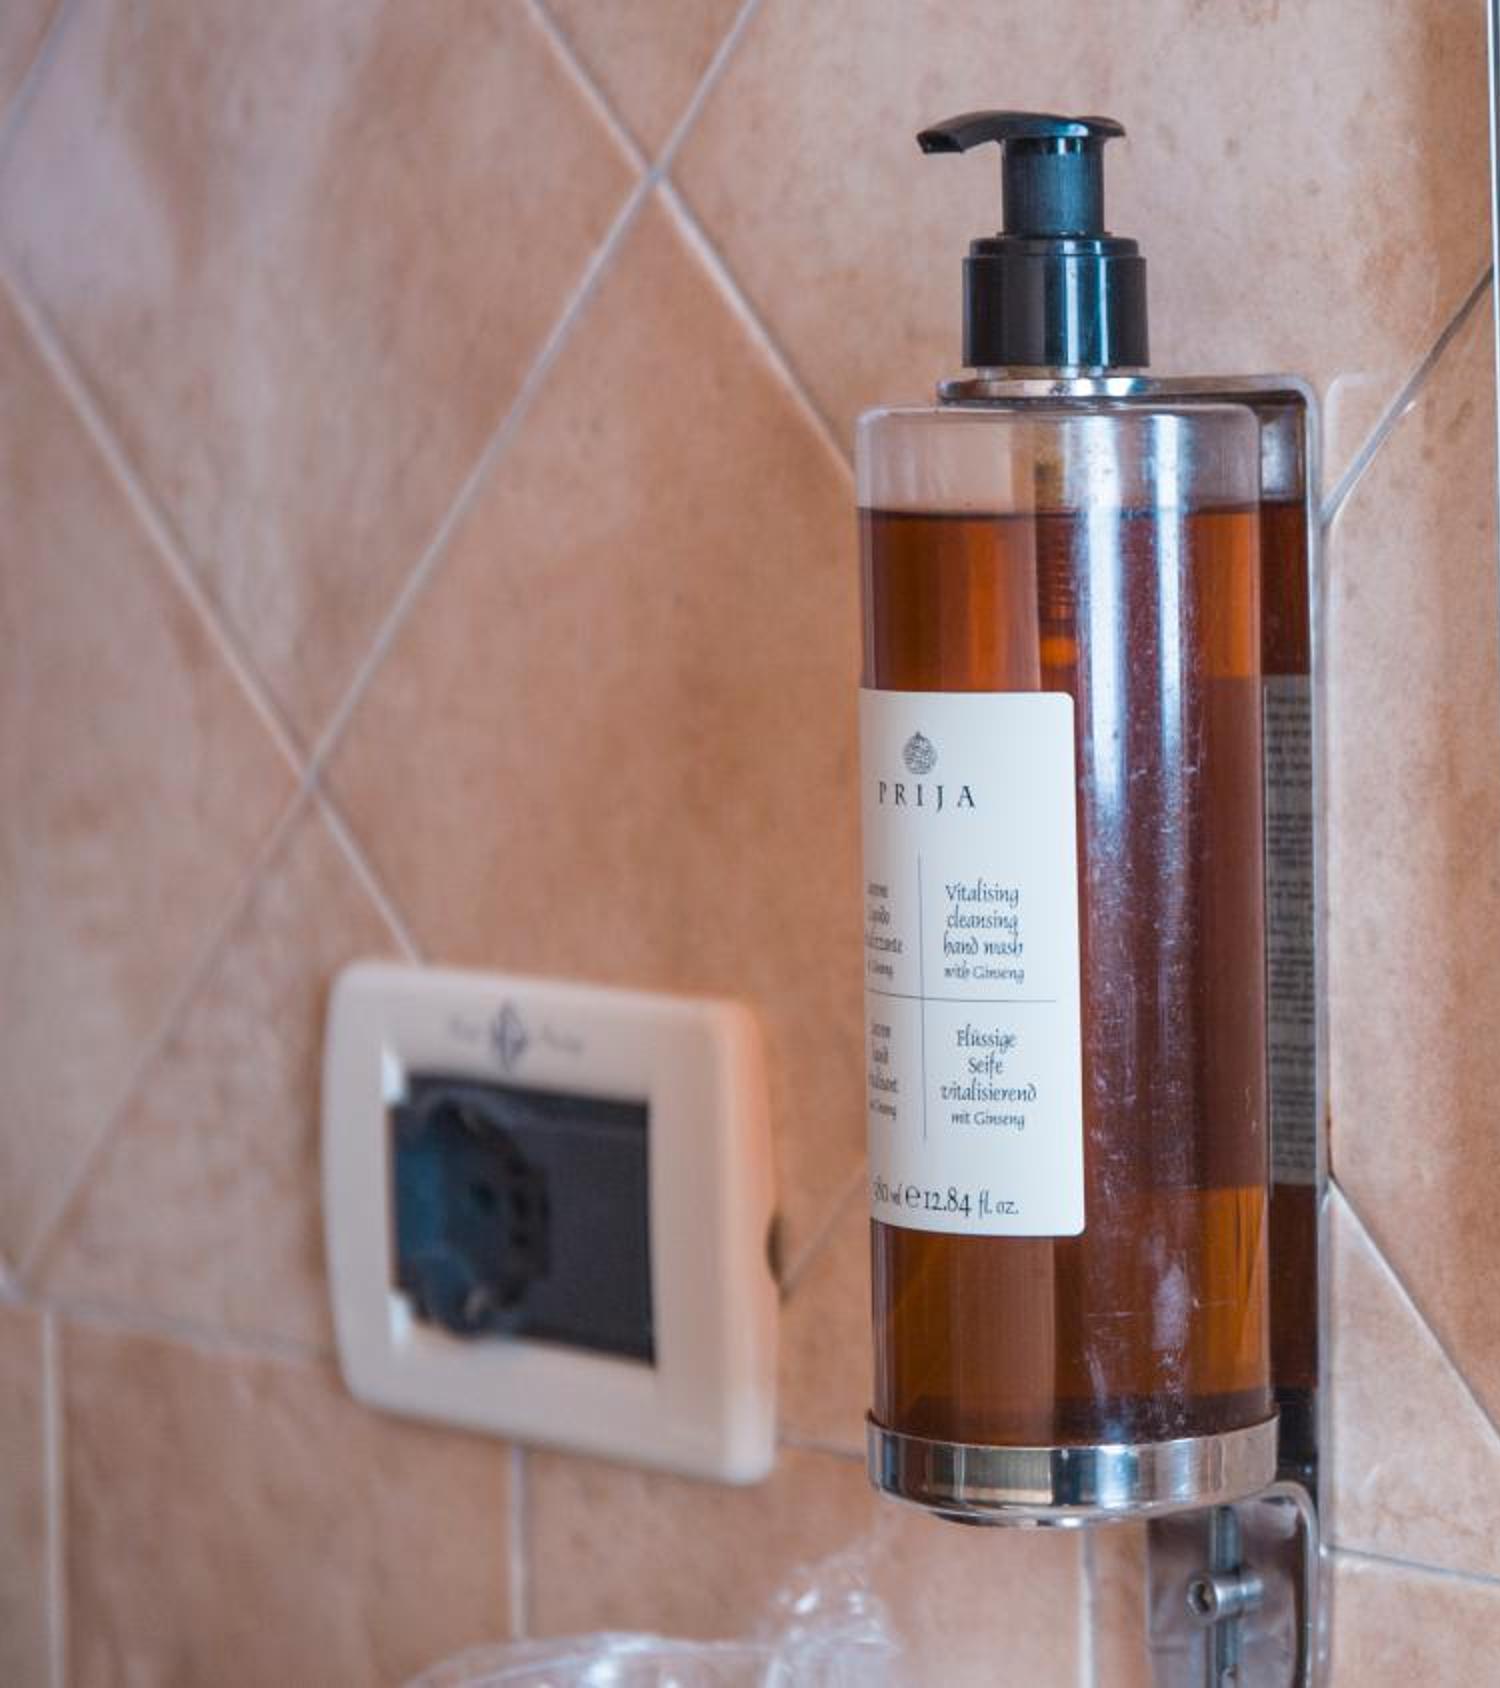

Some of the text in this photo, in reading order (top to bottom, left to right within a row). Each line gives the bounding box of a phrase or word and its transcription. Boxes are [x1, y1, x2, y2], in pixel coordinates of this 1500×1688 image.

[877, 780, 977, 811] PRIJA
[944, 877, 1019, 908] Vitalising
[947, 905, 1019, 935] cleansing
[943, 930, 1024, 958] hand wash
[943, 960, 1025, 985] with Ginseng
[956, 1023, 1018, 1054] Flüssige
[967, 1052, 1003, 1079] Seife
[940, 1077, 1038, 1104] vitalisierend
[951, 1110, 1025, 1130] mit Ginseng
[924, 1186, 971, 1218] 12.84
[995, 1201, 1019, 1216] oz.
